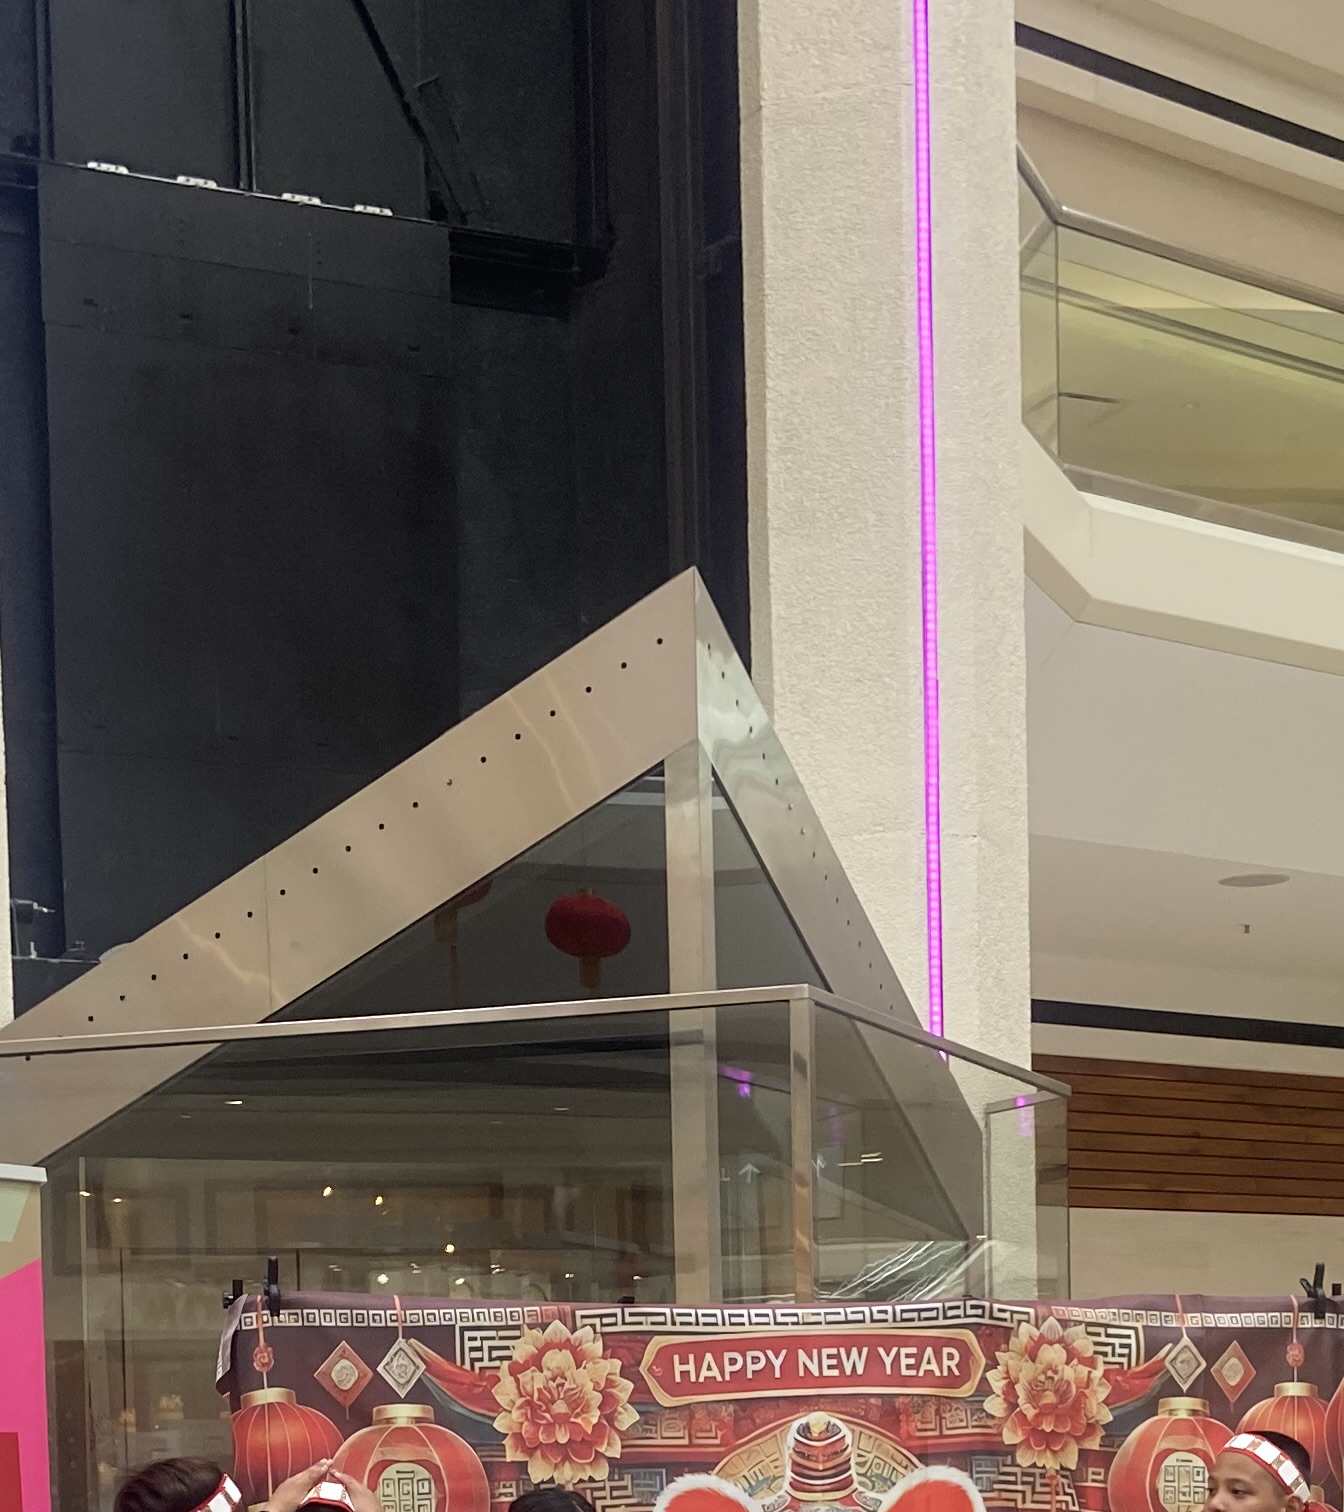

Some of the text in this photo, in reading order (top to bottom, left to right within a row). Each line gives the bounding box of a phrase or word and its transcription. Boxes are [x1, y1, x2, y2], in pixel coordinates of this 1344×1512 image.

[672, 1346, 961, 1383] HAPPY NEW YEAR
